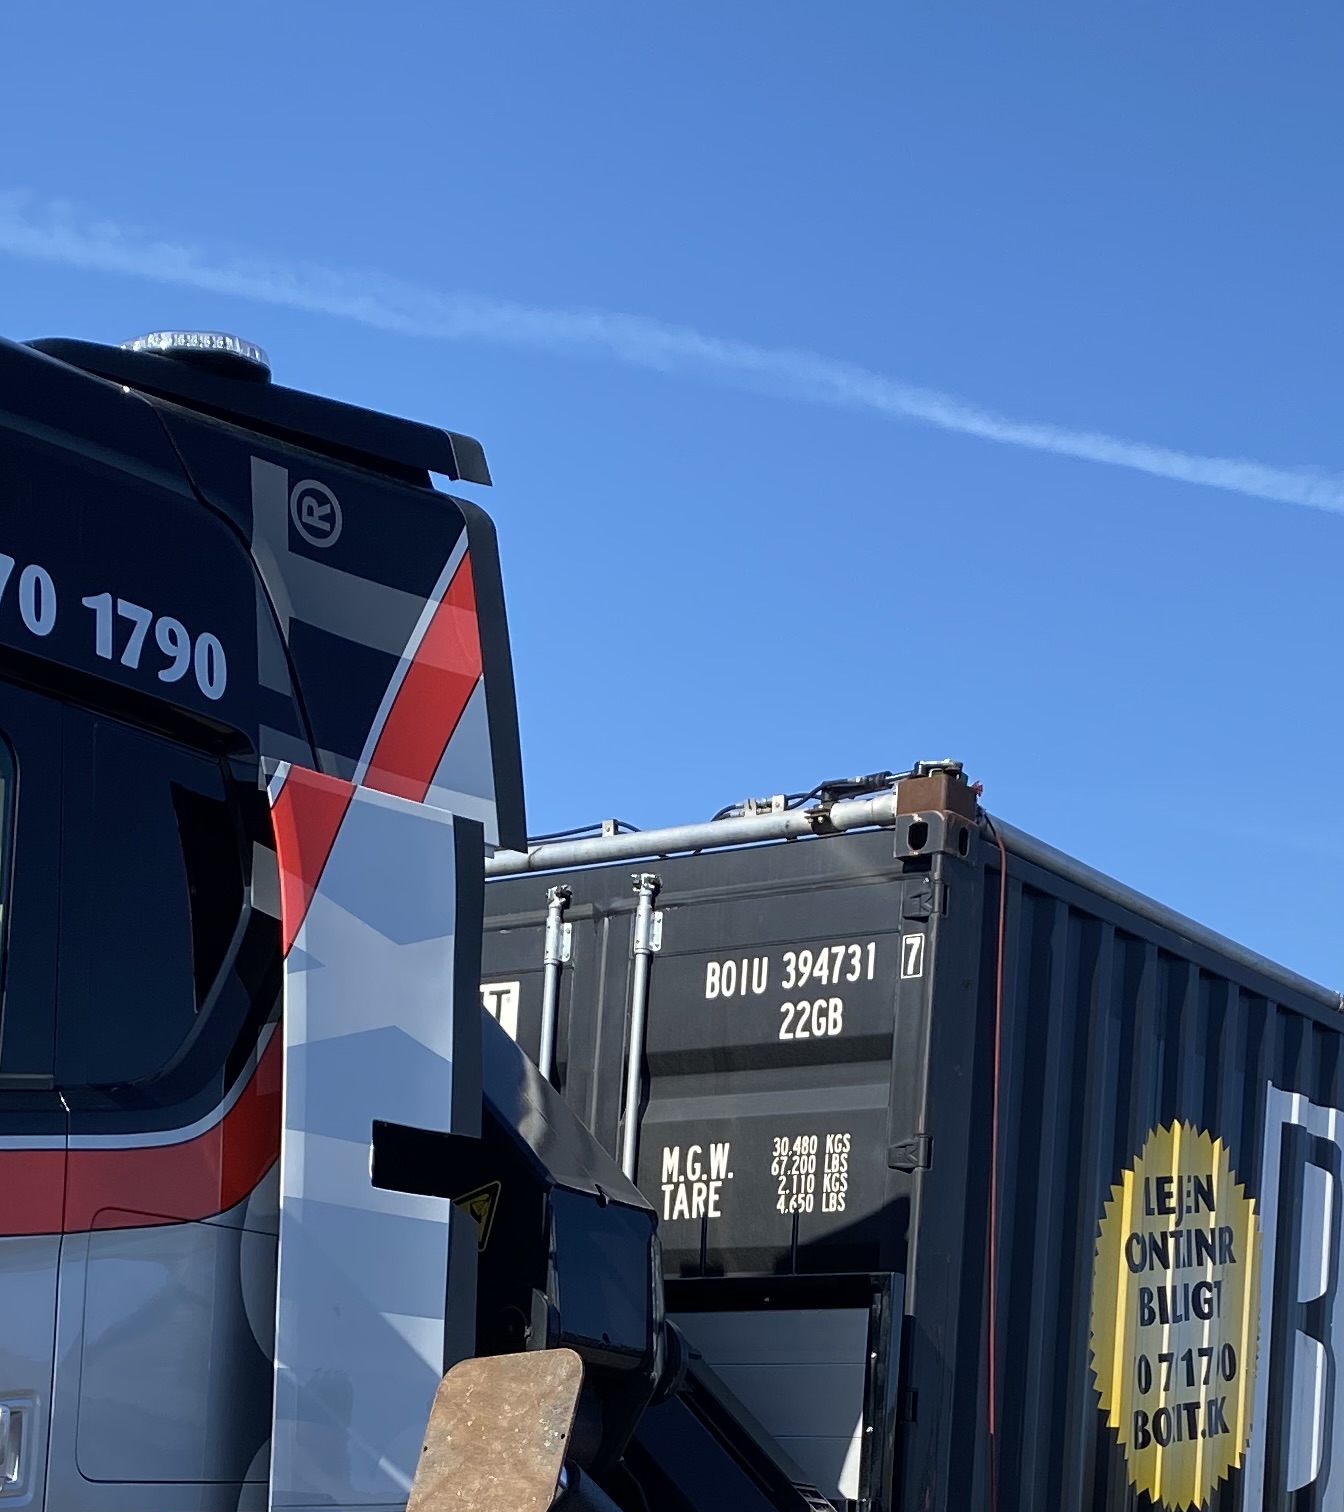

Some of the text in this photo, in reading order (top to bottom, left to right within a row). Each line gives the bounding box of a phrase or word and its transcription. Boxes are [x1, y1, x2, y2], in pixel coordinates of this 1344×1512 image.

[81, 592, 227, 700] 1790
[705, 935, 923, 999] BOIU 394731 7
[779, 997, 844, 1040] 22GB
[662, 1142, 734, 1183] M.G.W.
[825, 1133, 851, 1154] KGS
[824, 1154, 848, 1173] LBS
[661, 1181, 722, 1220] TARE
[822, 1172, 848, 1193] KGS
[821, 1192, 846, 1212] LBS
